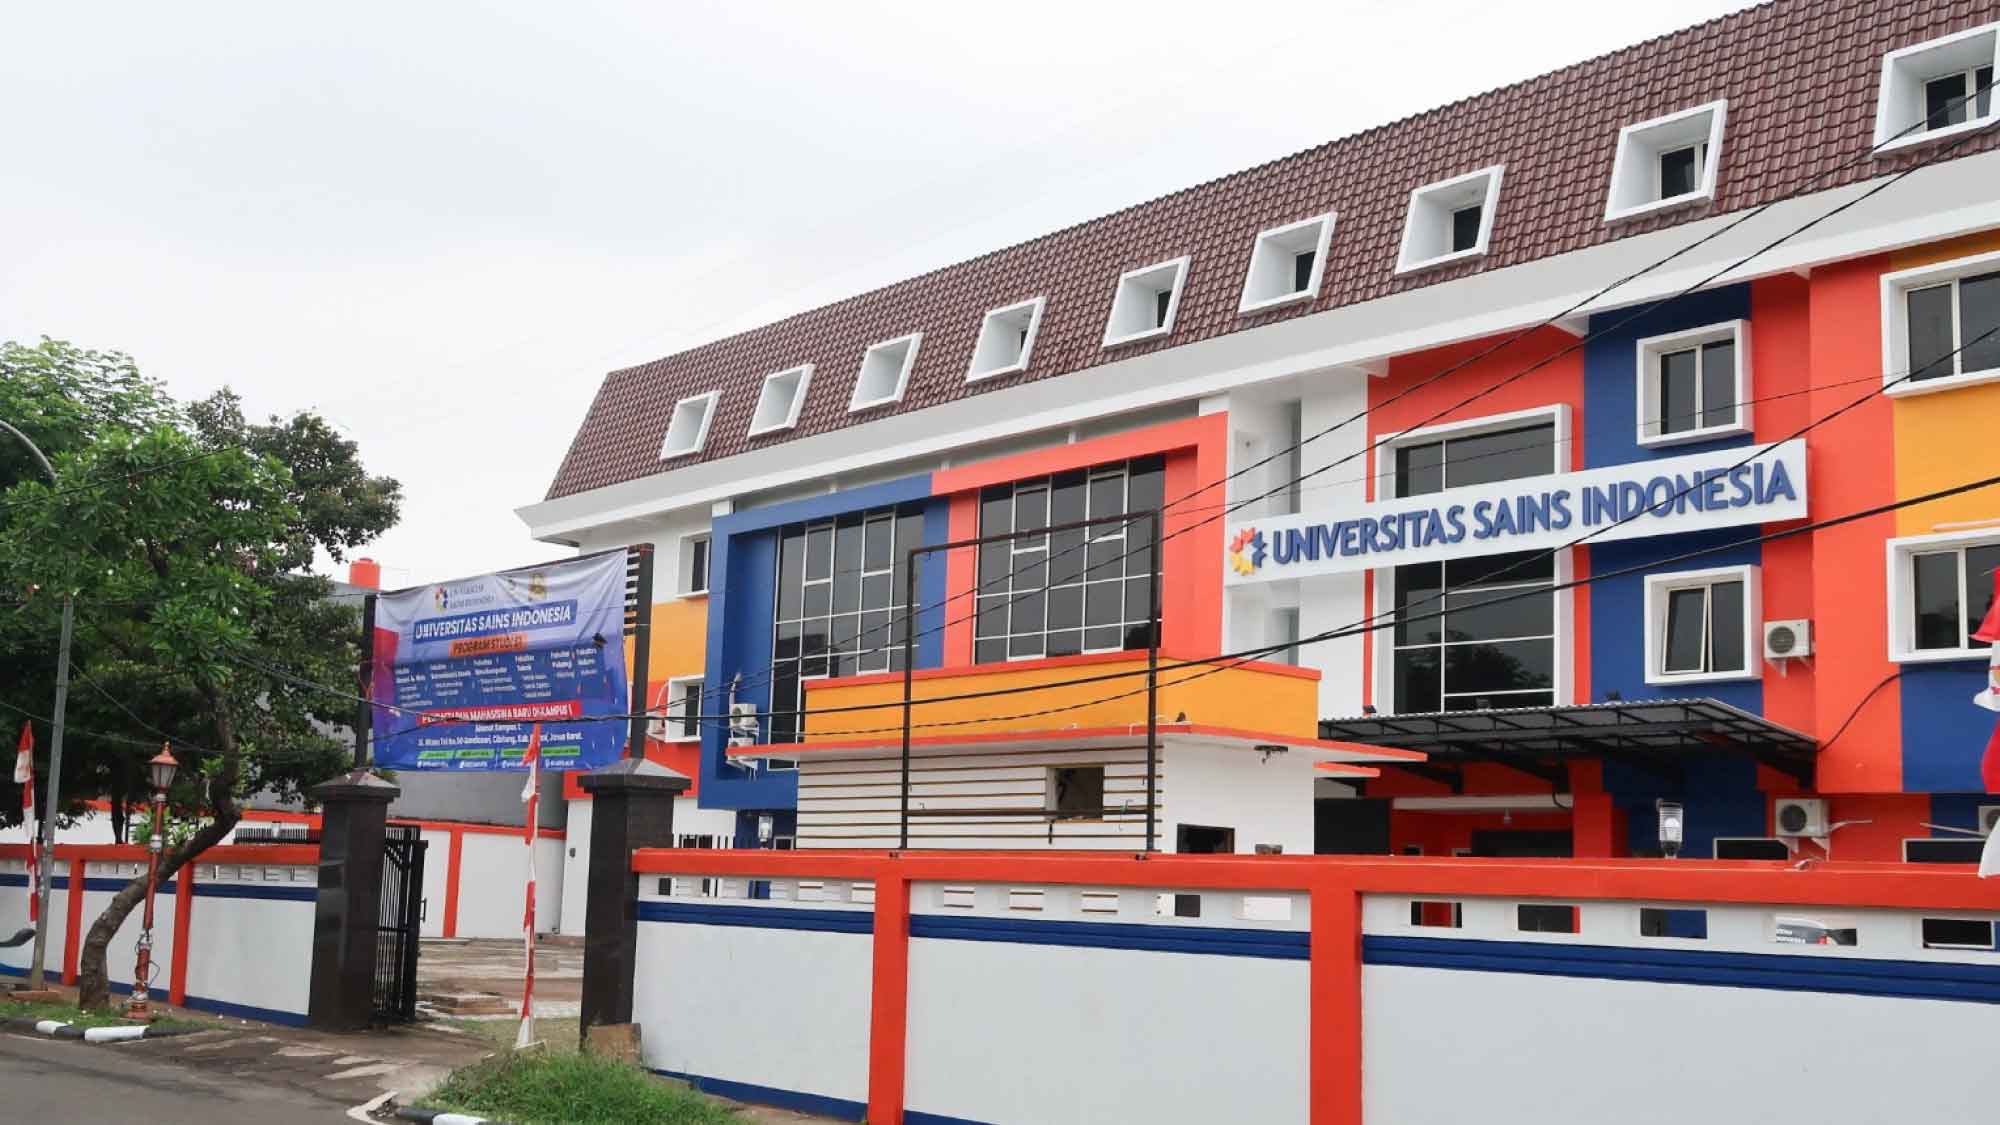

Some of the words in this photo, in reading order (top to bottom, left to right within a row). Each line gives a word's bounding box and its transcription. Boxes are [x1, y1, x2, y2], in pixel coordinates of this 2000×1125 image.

[1272, 505, 1466, 565] UNIVERSITAS
[1473, 491, 1571, 543] SAINS
[1583, 459, 1796, 526] INDONESIA
[415, 619, 478, 639] UNIVERSITAS
[478, 613, 510, 631] SAINS
[511, 606, 571, 627] INDONESIA
